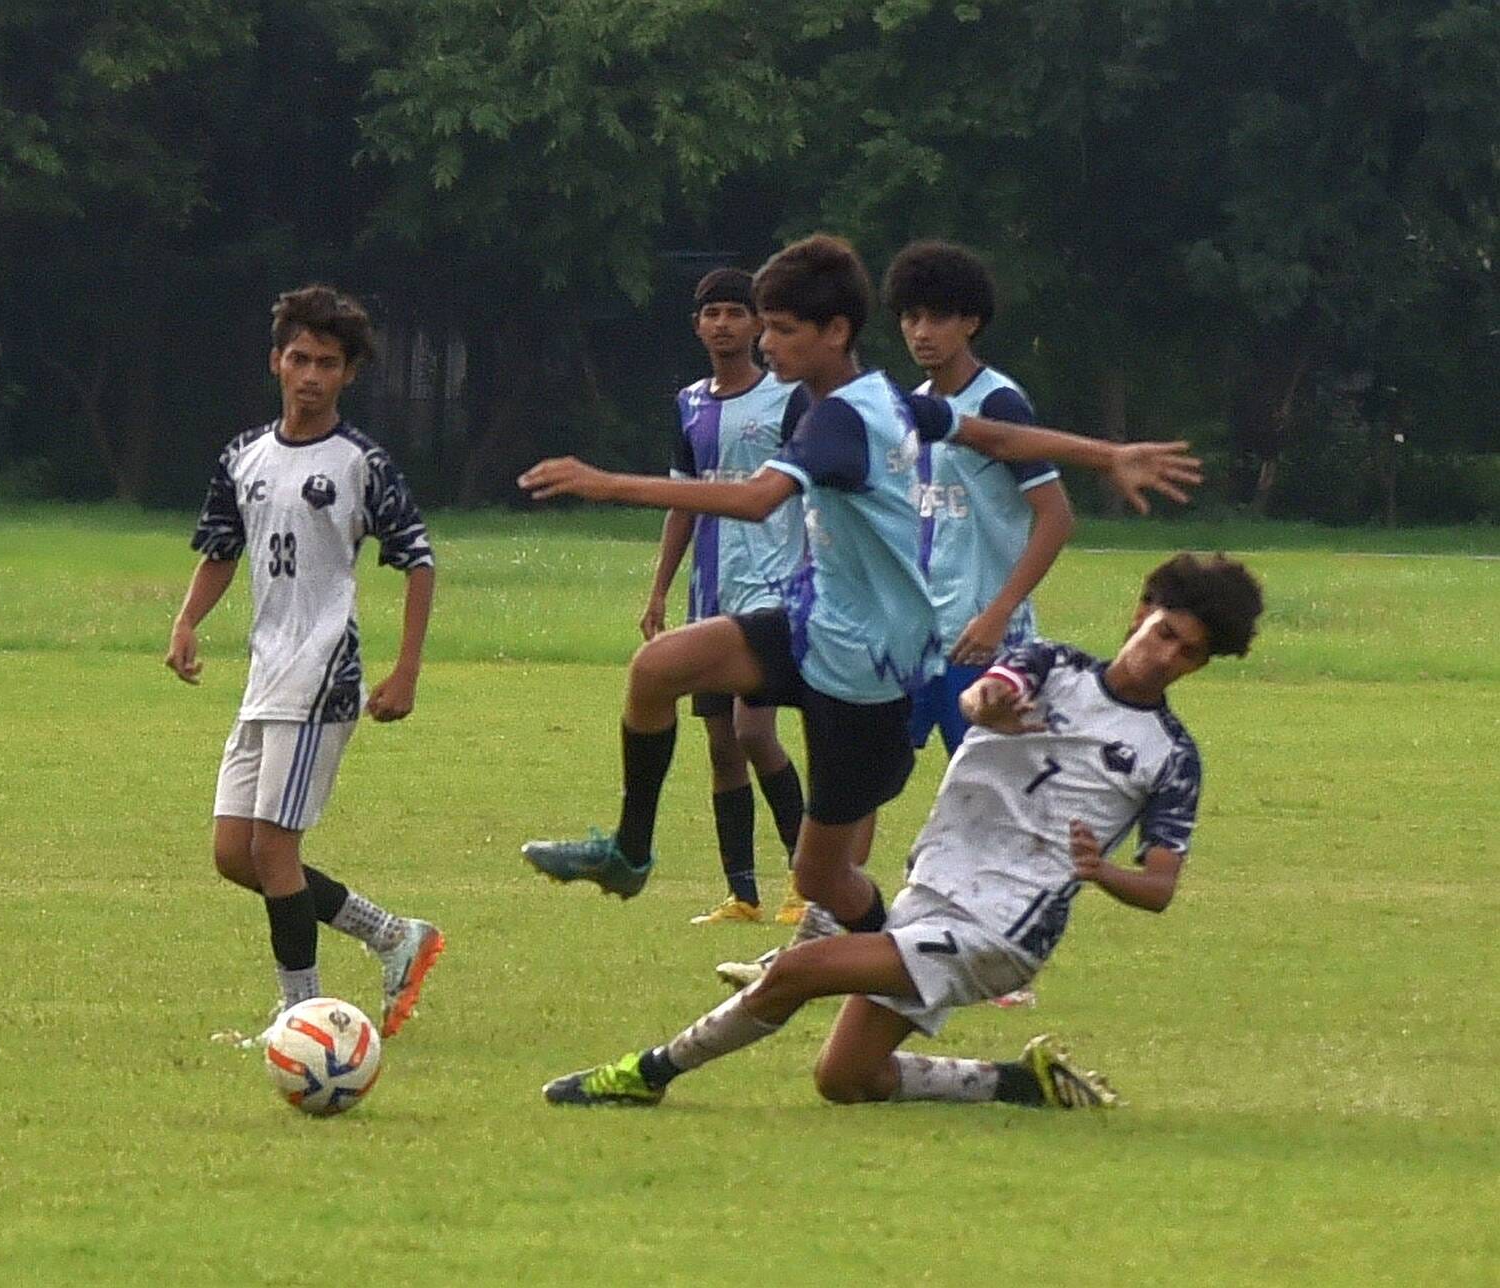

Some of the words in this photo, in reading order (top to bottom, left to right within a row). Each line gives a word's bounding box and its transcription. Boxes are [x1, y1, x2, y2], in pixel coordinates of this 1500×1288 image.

[268, 532, 297, 578] 33
[1024, 757, 1062, 794] 7
[916, 930, 959, 955] 7
